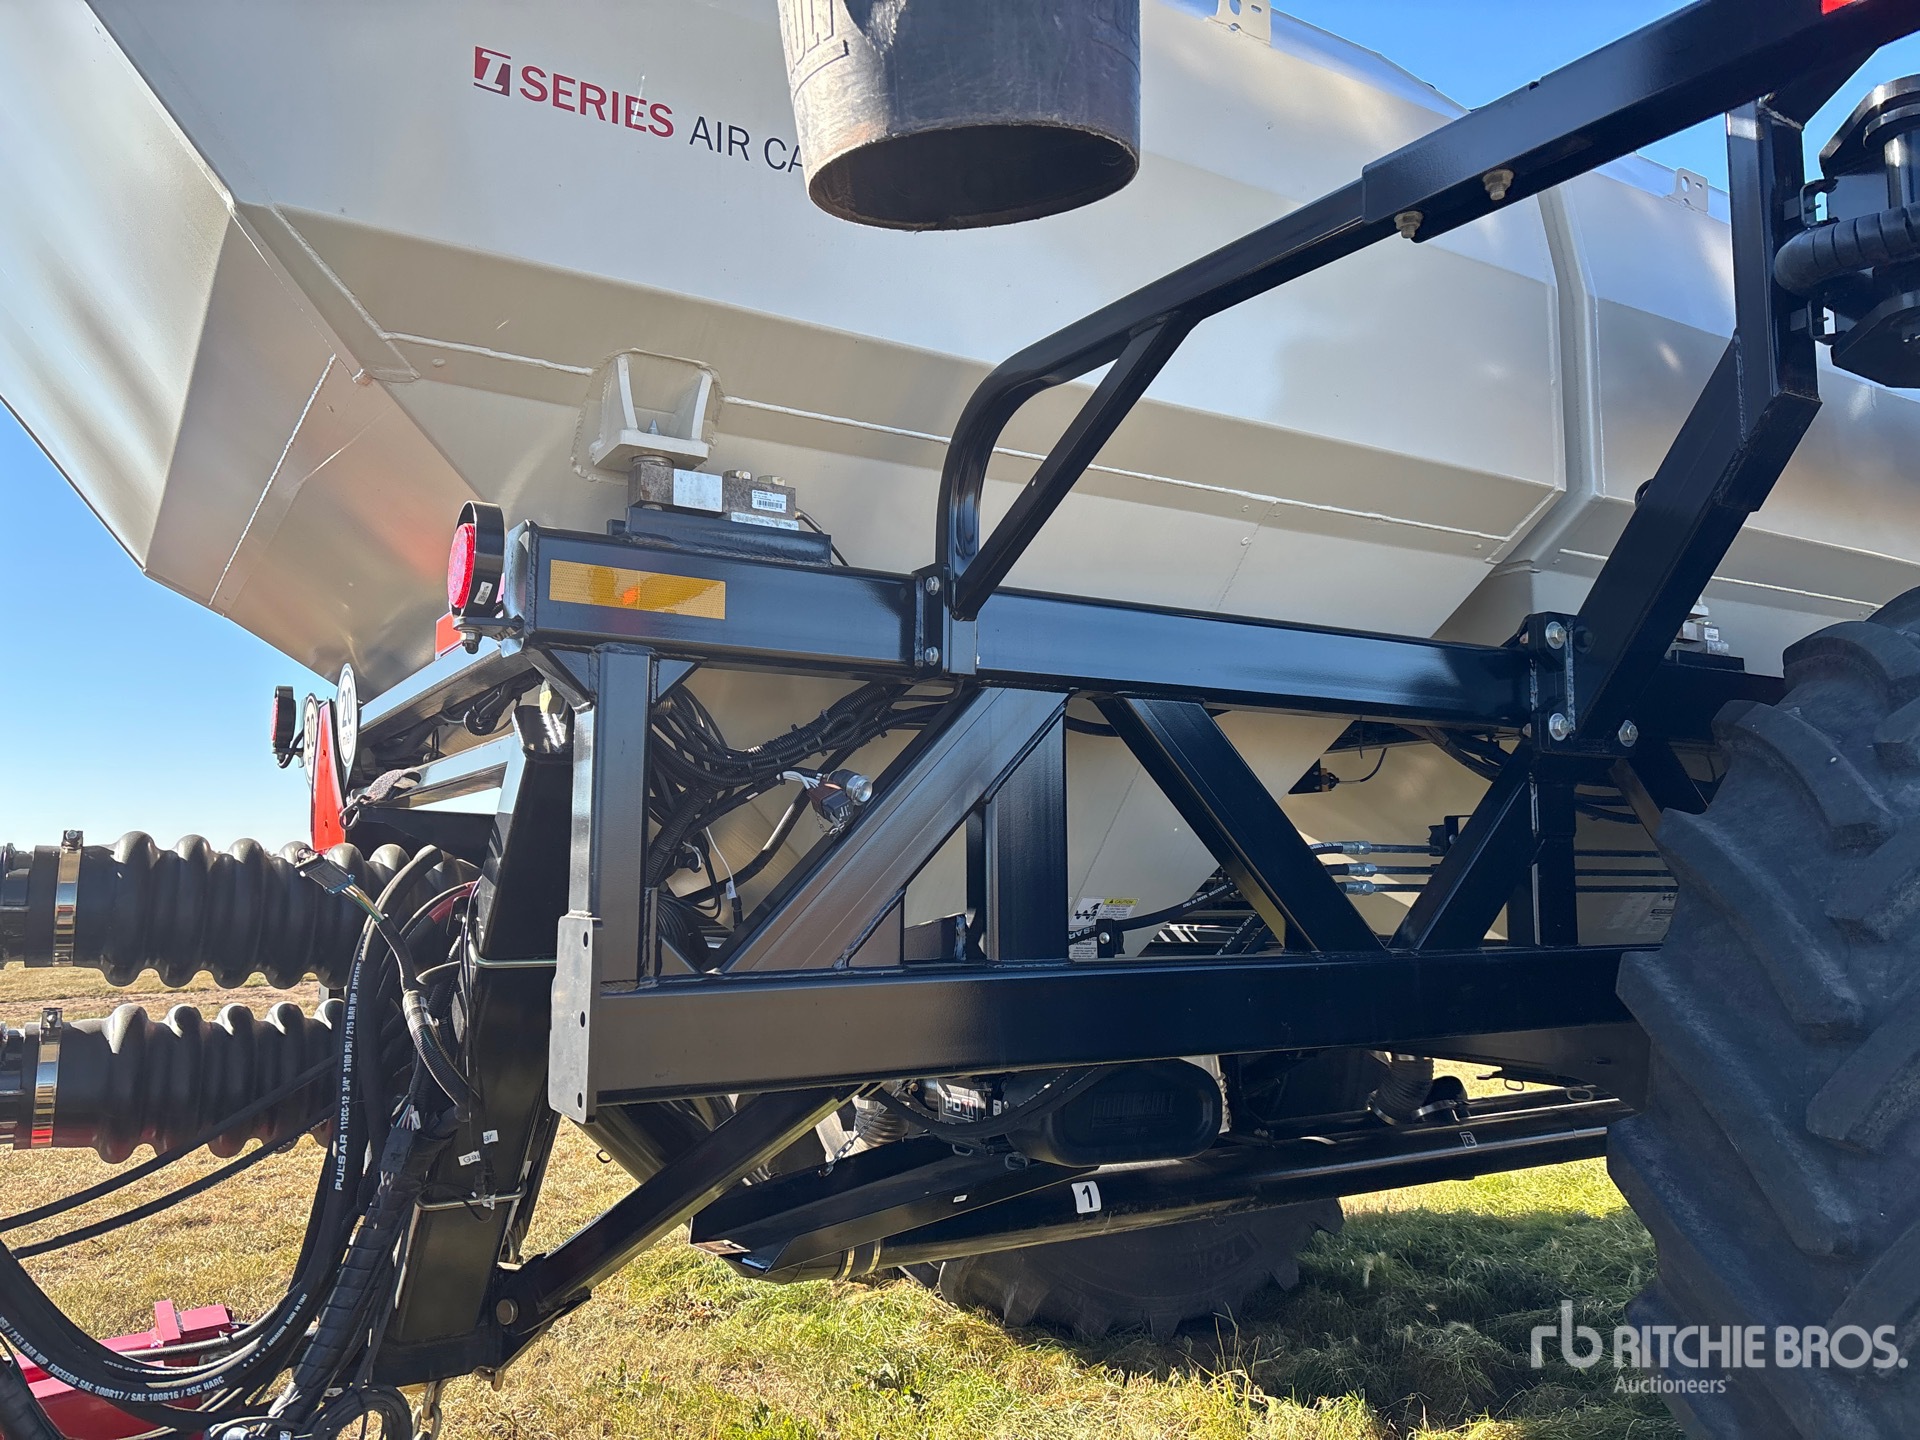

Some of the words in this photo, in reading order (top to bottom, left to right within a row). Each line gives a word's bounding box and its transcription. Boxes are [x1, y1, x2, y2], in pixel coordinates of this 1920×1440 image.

[519, 65, 675, 138] SERIES
[689, 115, 751, 162] AIR
[763, 136, 803, 174] CA
[342, 687, 352, 728] 20
[349, 993, 358, 1005] WP
[347, 1006, 356, 1020] BAR
[346, 1021, 355, 1035] 215
[345, 1041, 353, 1053] PSI
[343, 1054, 352, 1073] 3100
[335, 1134, 348, 1191] PULSAR
[1081, 1184, 1093, 1208] 1
[9, 1330, 25, 1345] 215
[20, 1342, 38, 1358] BAR
[34, 1353, 49, 1365] WP
[47, 1363, 79, 1385] EXCEEDS
[78, 1380, 94, 1392] SAE
[95, 1385, 125, 1399] 100R17
[130, 1393, 146, 1402] SAE
[147, 1391, 179, 1402] 100R16
